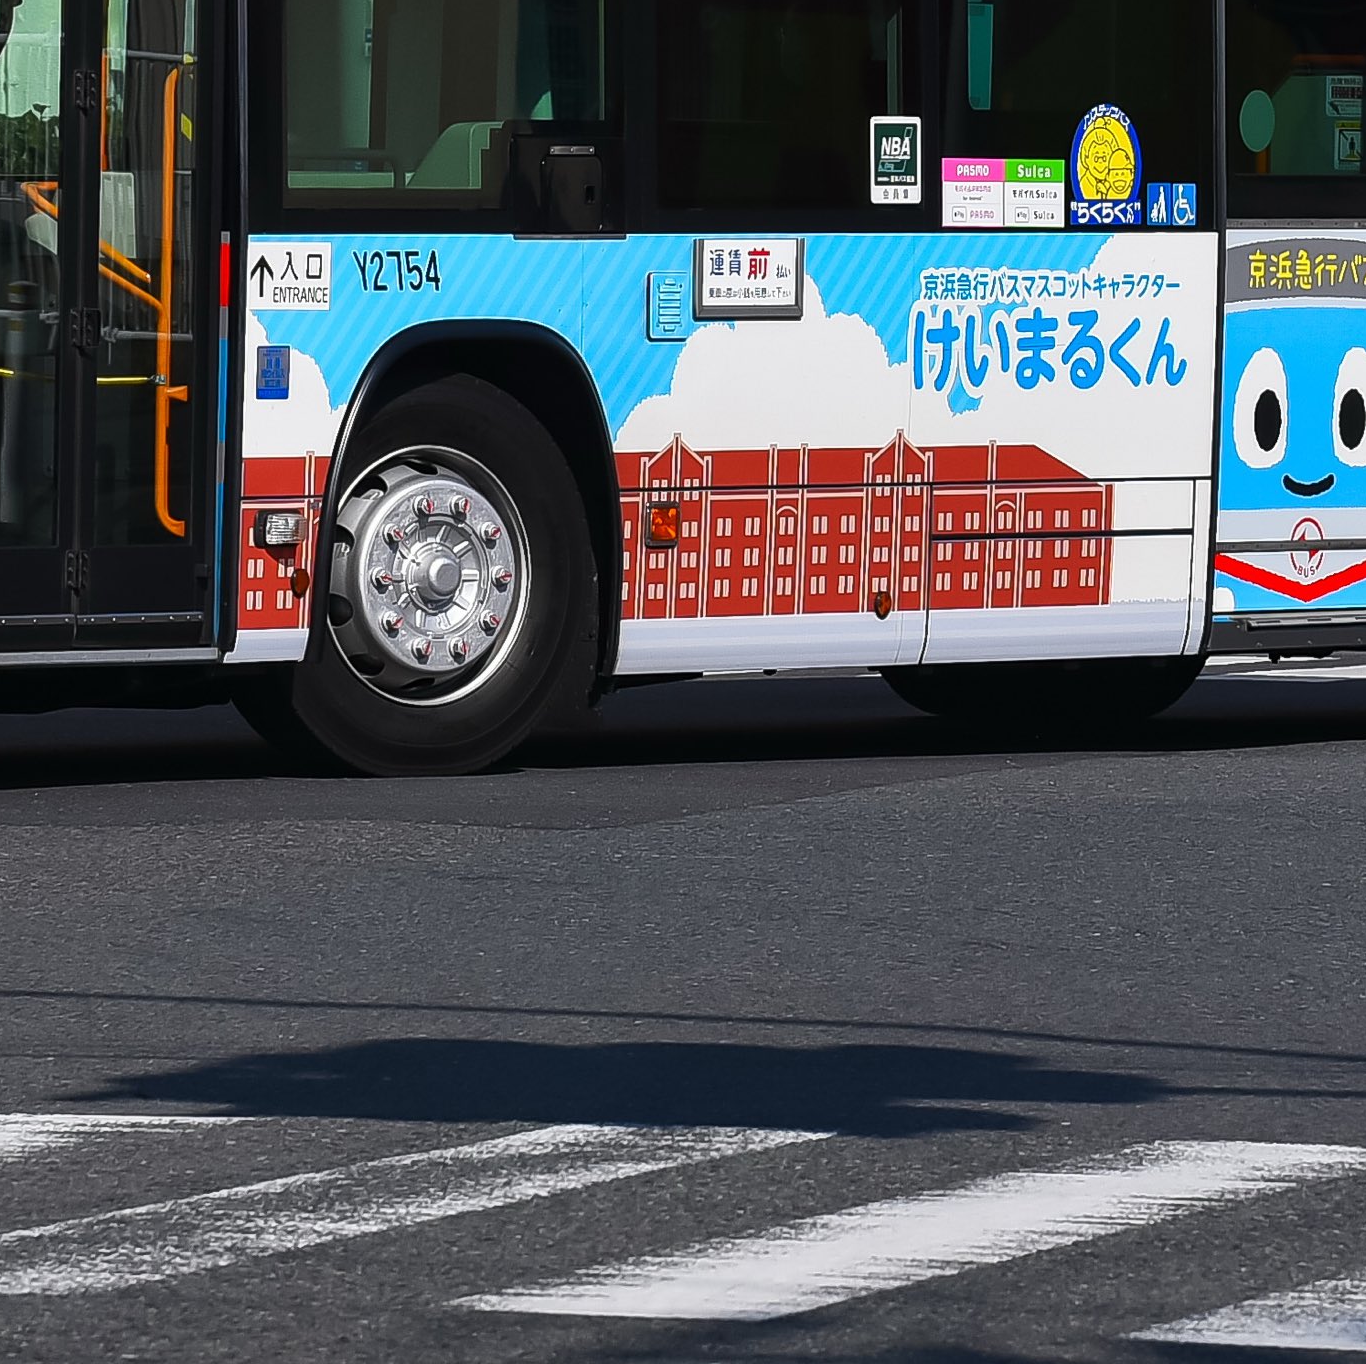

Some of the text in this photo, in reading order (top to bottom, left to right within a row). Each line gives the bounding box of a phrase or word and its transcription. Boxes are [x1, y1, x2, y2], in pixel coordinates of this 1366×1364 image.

[881, 136, 910, 157] NBA
[956, 164, 1051, 178] PASMO Suica
[280, 251, 323, 281] 入口
[352, 250, 441, 292] Y2754
[273, 287, 328, 303] ENTRANCE
[923, 273, 1180, 300] 京浜急行バスマスコットキャラクター
[913, 307, 1187, 390] けいまるくん
[1298, 566, 1315, 577] BUS
